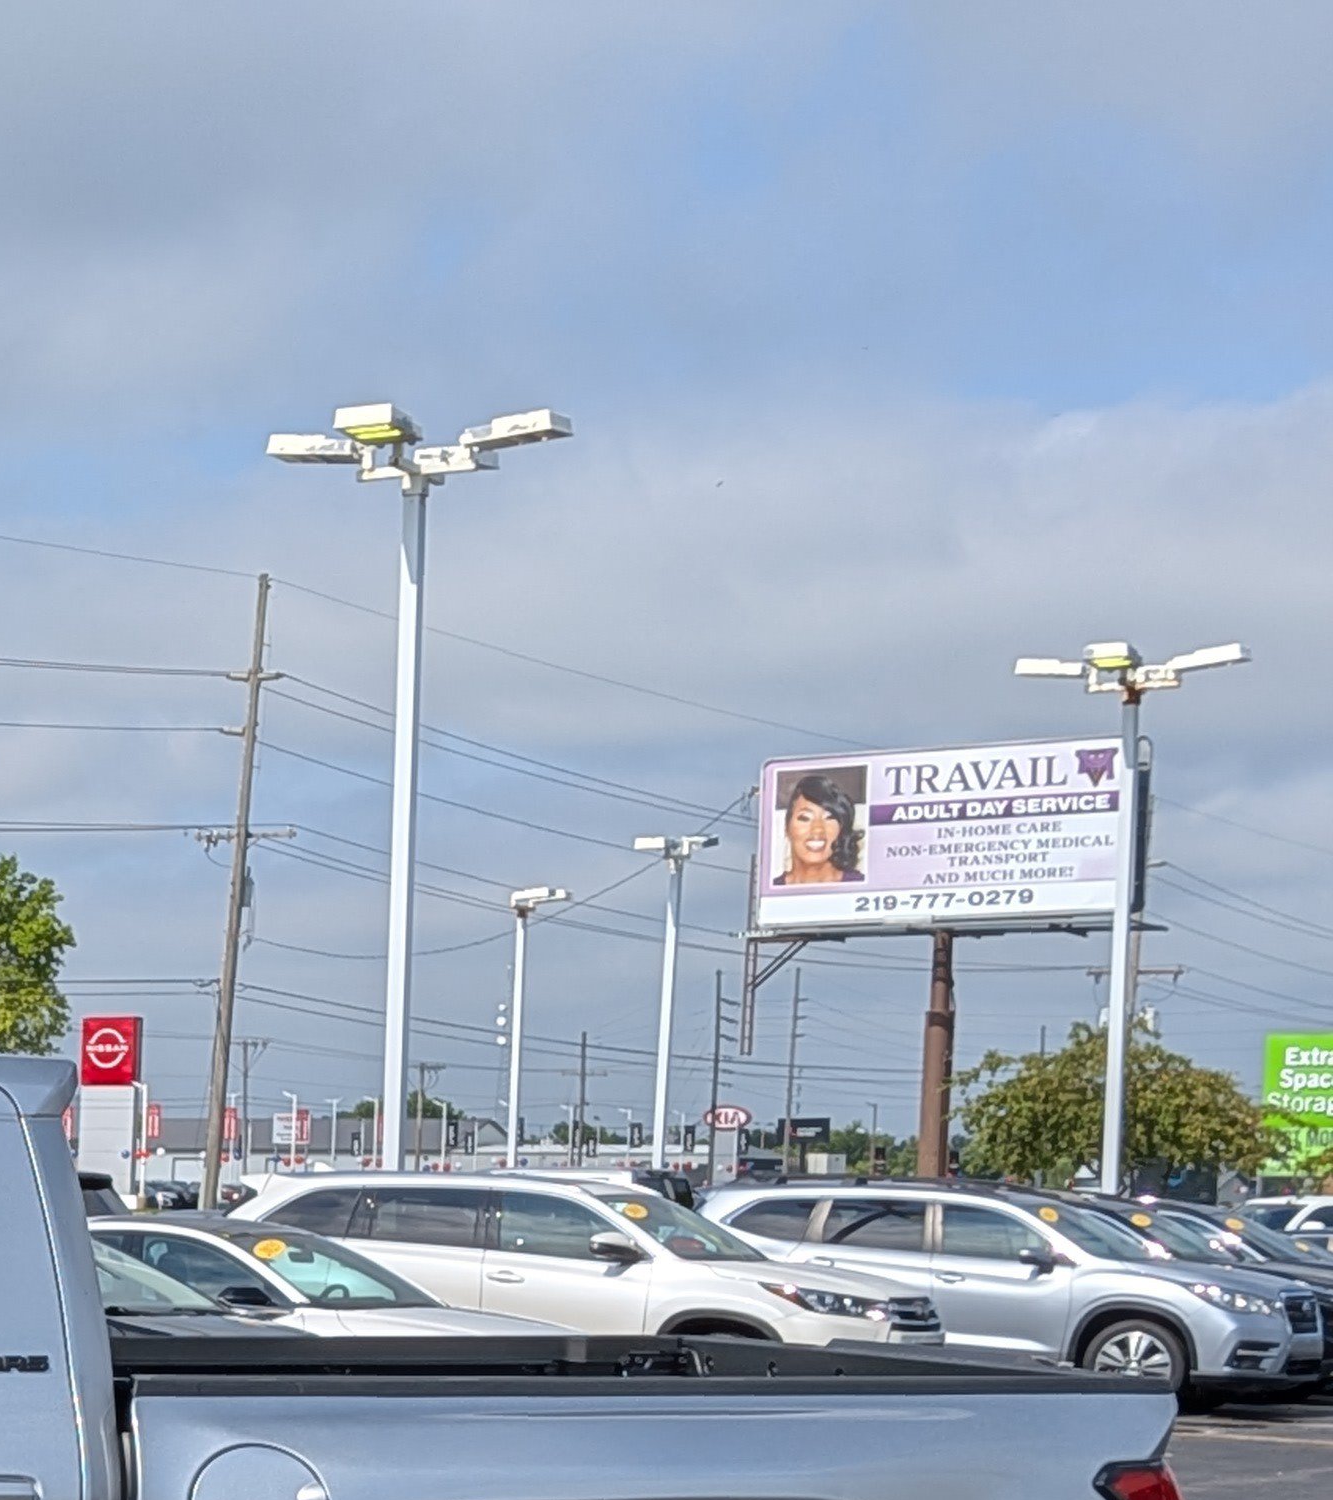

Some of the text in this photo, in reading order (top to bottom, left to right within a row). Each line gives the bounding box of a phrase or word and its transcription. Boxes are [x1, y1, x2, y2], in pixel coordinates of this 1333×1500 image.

[884, 756, 1068, 796] TRAVAIL
[892, 794, 1111, 821] ADULT DAY SERVICE
[936, 820, 1063, 839] IN-HOME CARE
[886, 834, 1115, 858] NON-EMERGENCY MEDICAL
[947, 851, 1050, 867] TRANSPORT
[923, 865, 1075, 885] AND MUCH MORE!
[855, 888, 1035, 912] 219-777-0279
[86, 1044, 129, 1053] NISSAN
[1285, 1046, 1333, 1066] Extra
[1279, 1068, 1333, 1092] Spac
[711, 1110, 741, 1126] KIA
